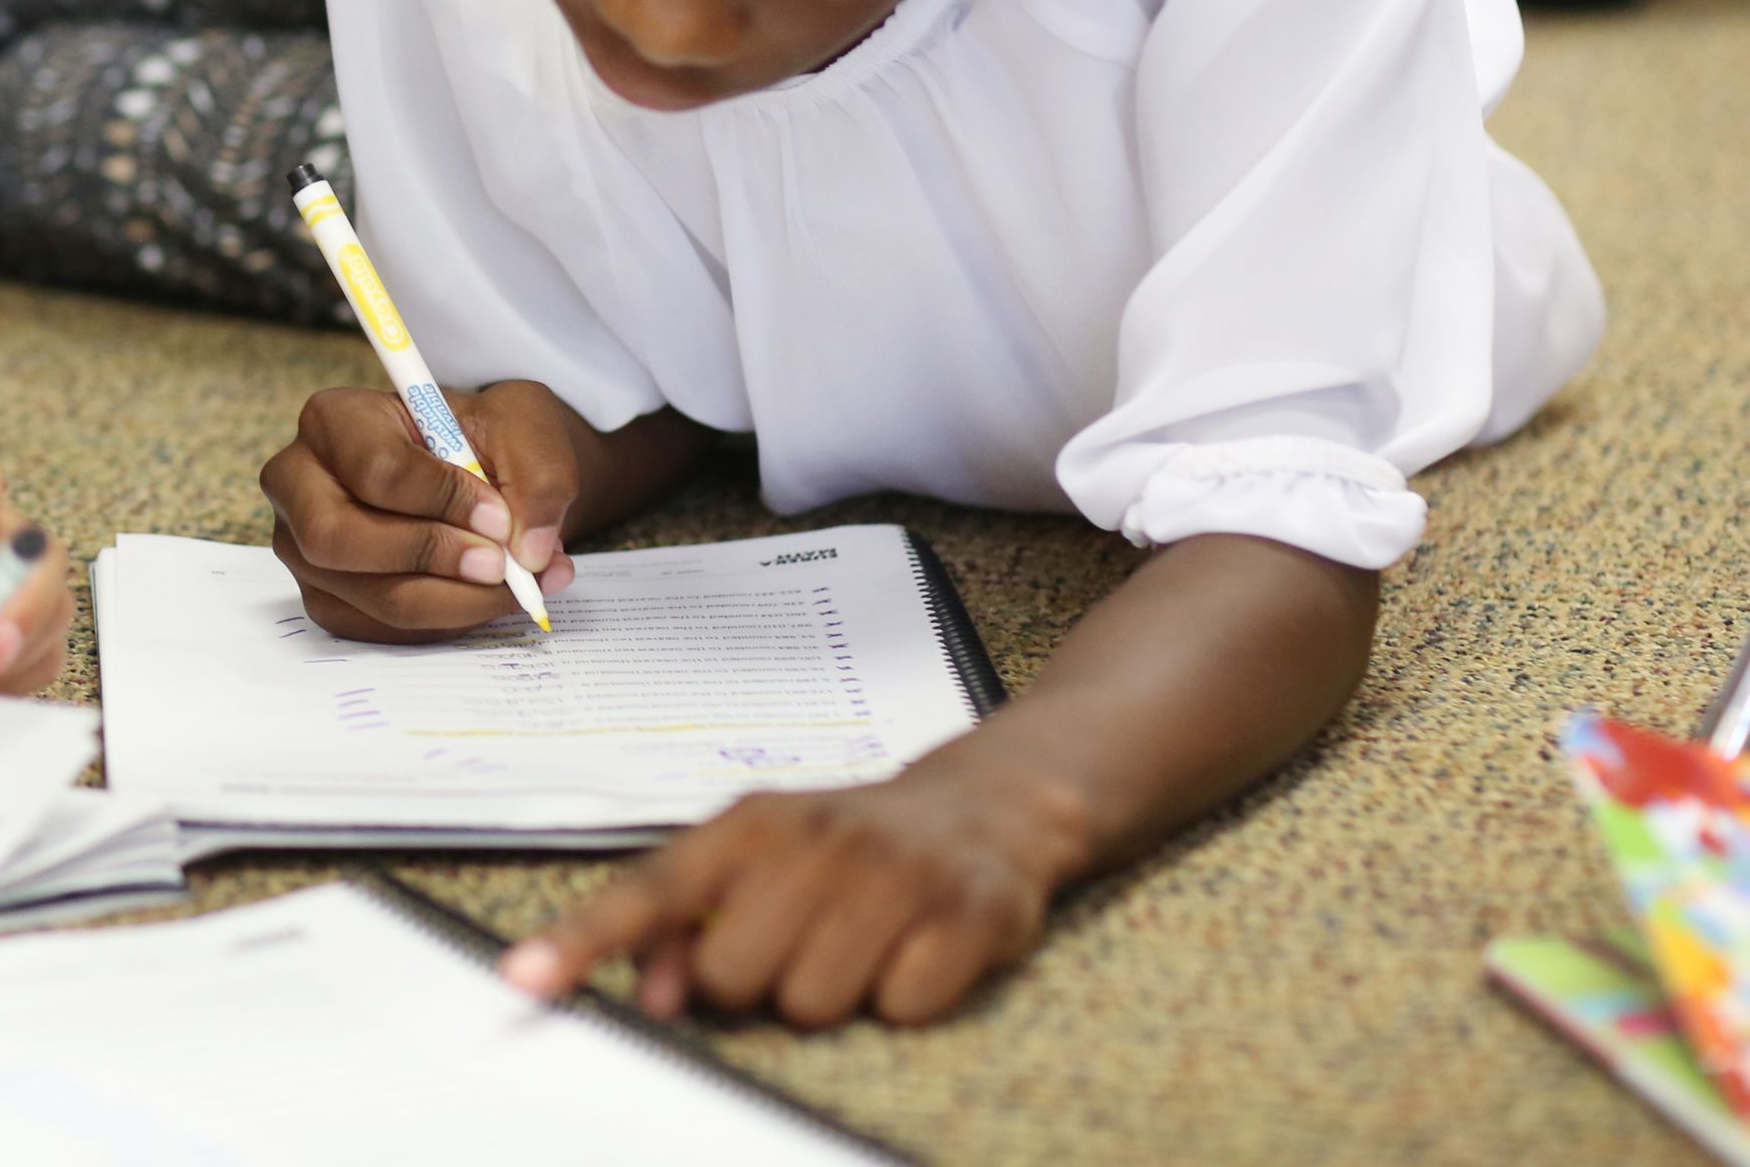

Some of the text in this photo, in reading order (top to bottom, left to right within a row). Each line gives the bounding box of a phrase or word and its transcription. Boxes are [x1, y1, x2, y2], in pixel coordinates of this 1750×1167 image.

[346, 252, 406, 343] Crayola
[407, 384, 464, 453] washable
[423, 382, 463, 437] lavable
